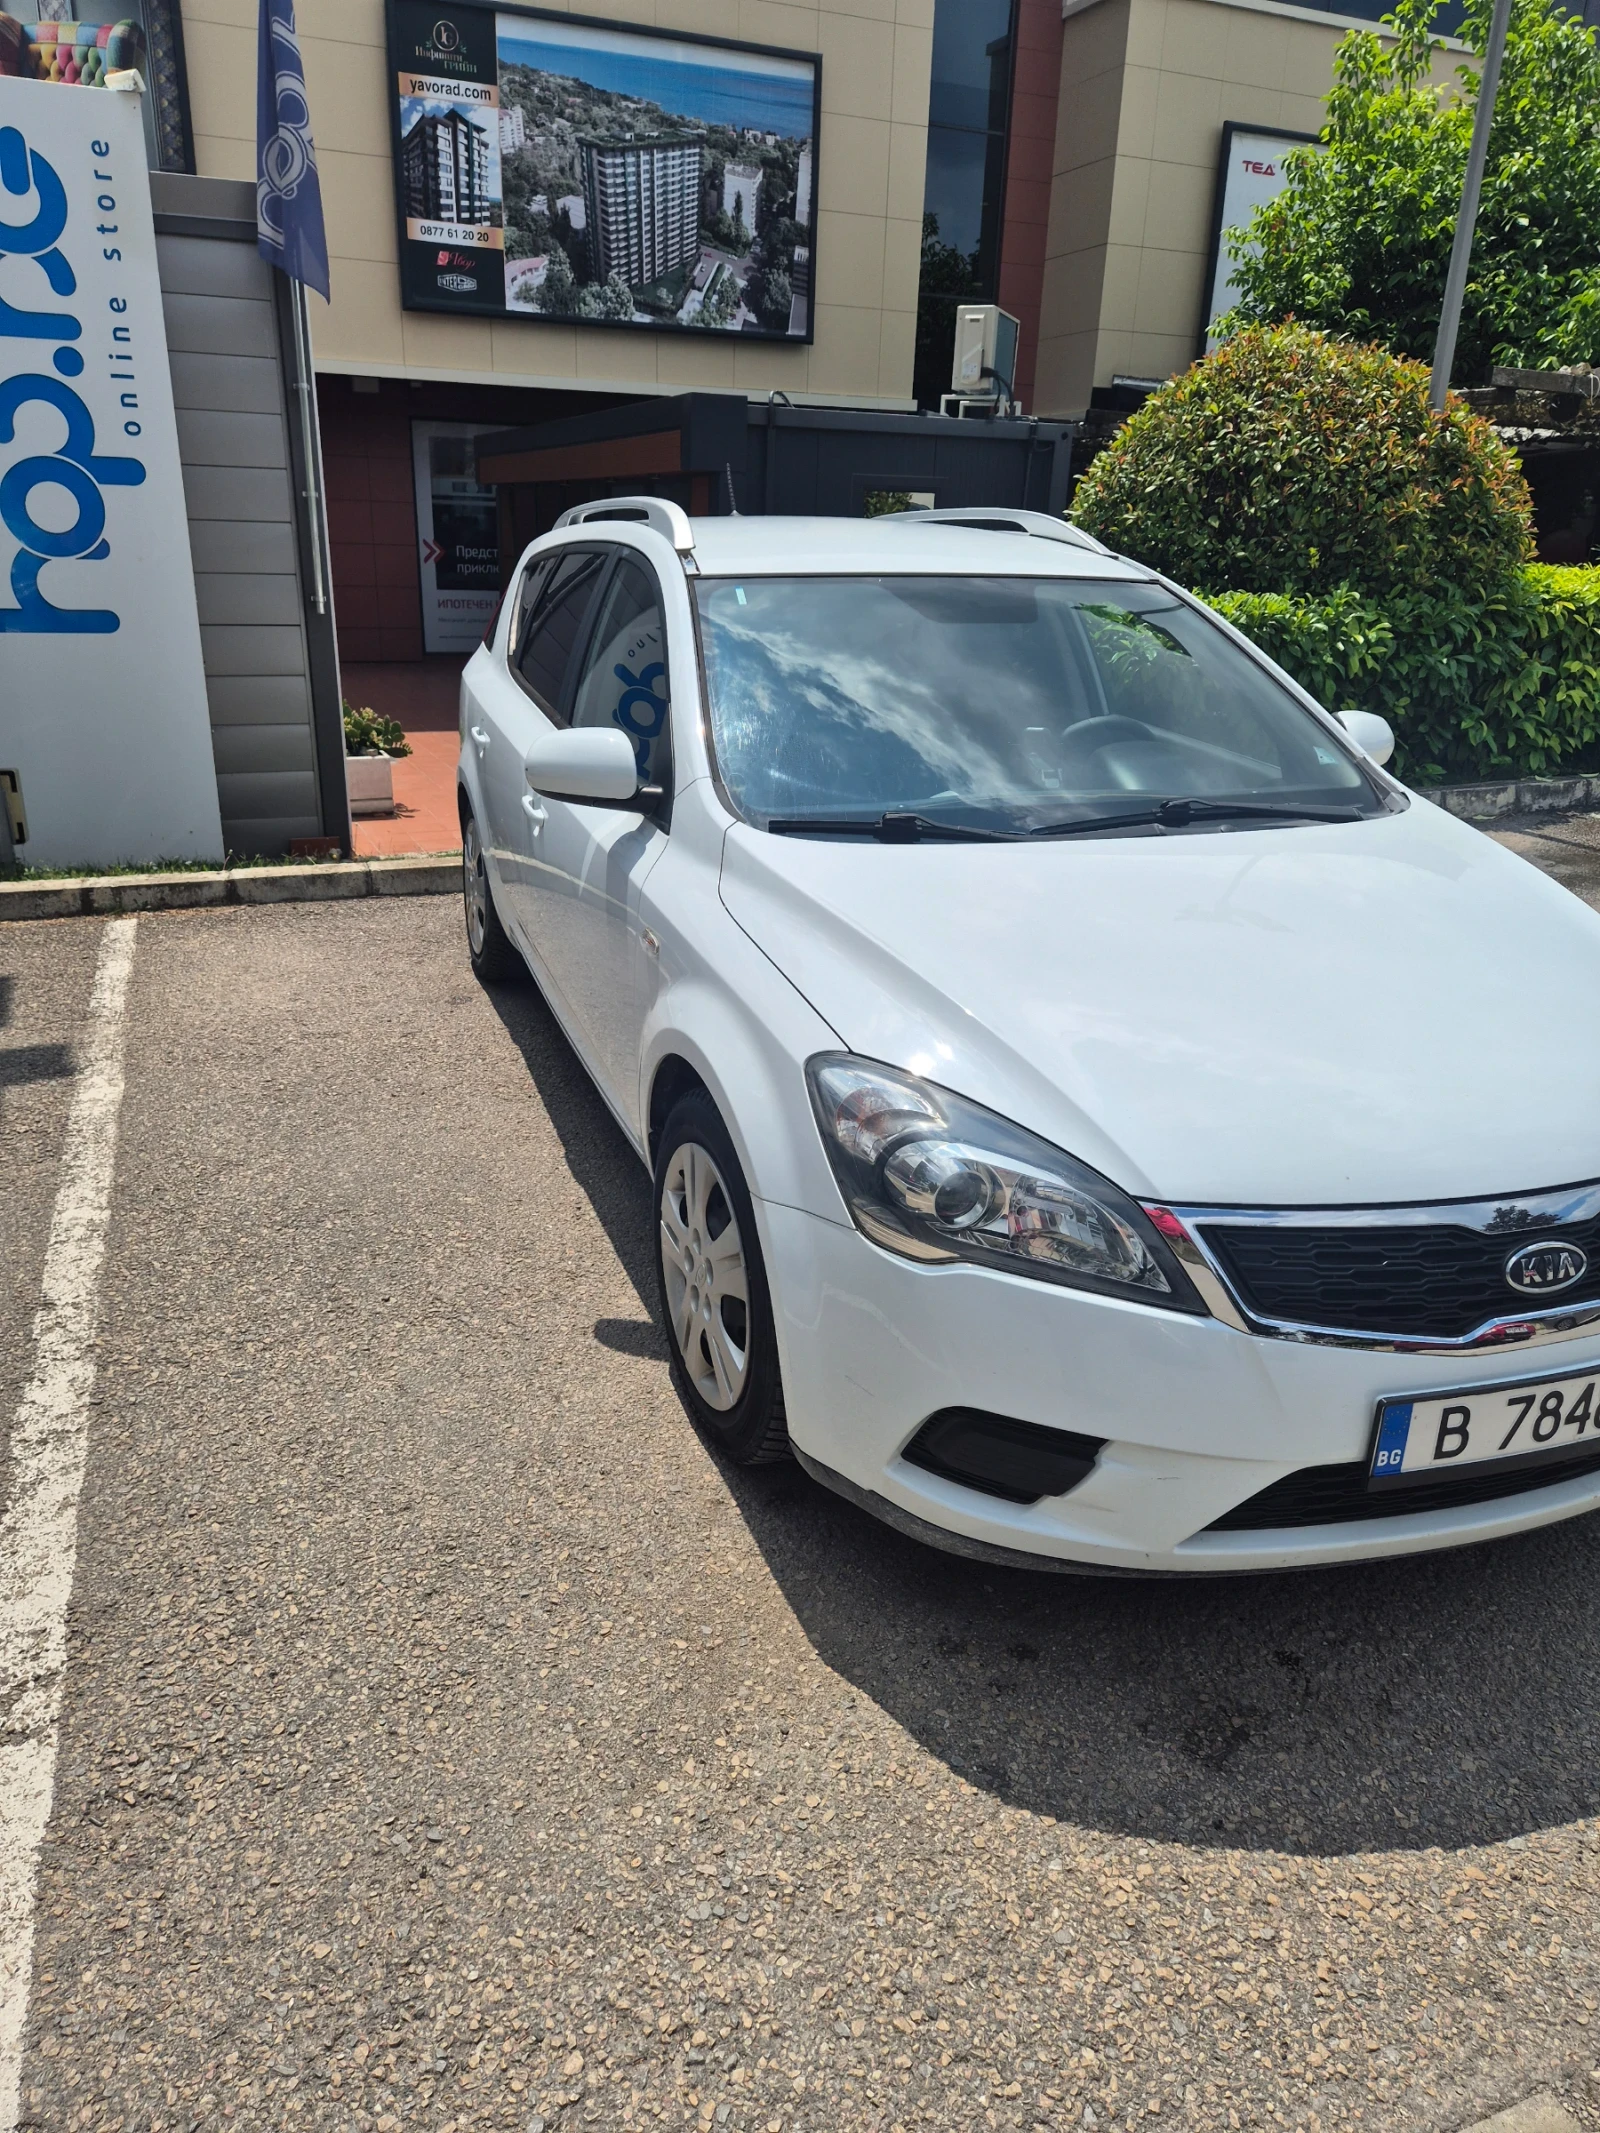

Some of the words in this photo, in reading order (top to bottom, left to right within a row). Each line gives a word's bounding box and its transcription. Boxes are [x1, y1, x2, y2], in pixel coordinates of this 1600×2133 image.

[409, 79, 491, 101] yavorad.com
[91, 139, 122, 262] store
[420, 225, 444, 237] 0877
[447, 228, 458, 239] 61
[462, 230, 474, 241] 20
[477, 231, 489, 242] 20
[109, 297, 141, 436] online
[437, 598, 493, 609] ИПОТЕЧЕН
[1520, 1251, 1576, 1285] KIA
[1433, 1405, 1471, 1460] B
[1498, 1382, 1600, 1451] 784
[1376, 1449, 1402, 1467] BG
